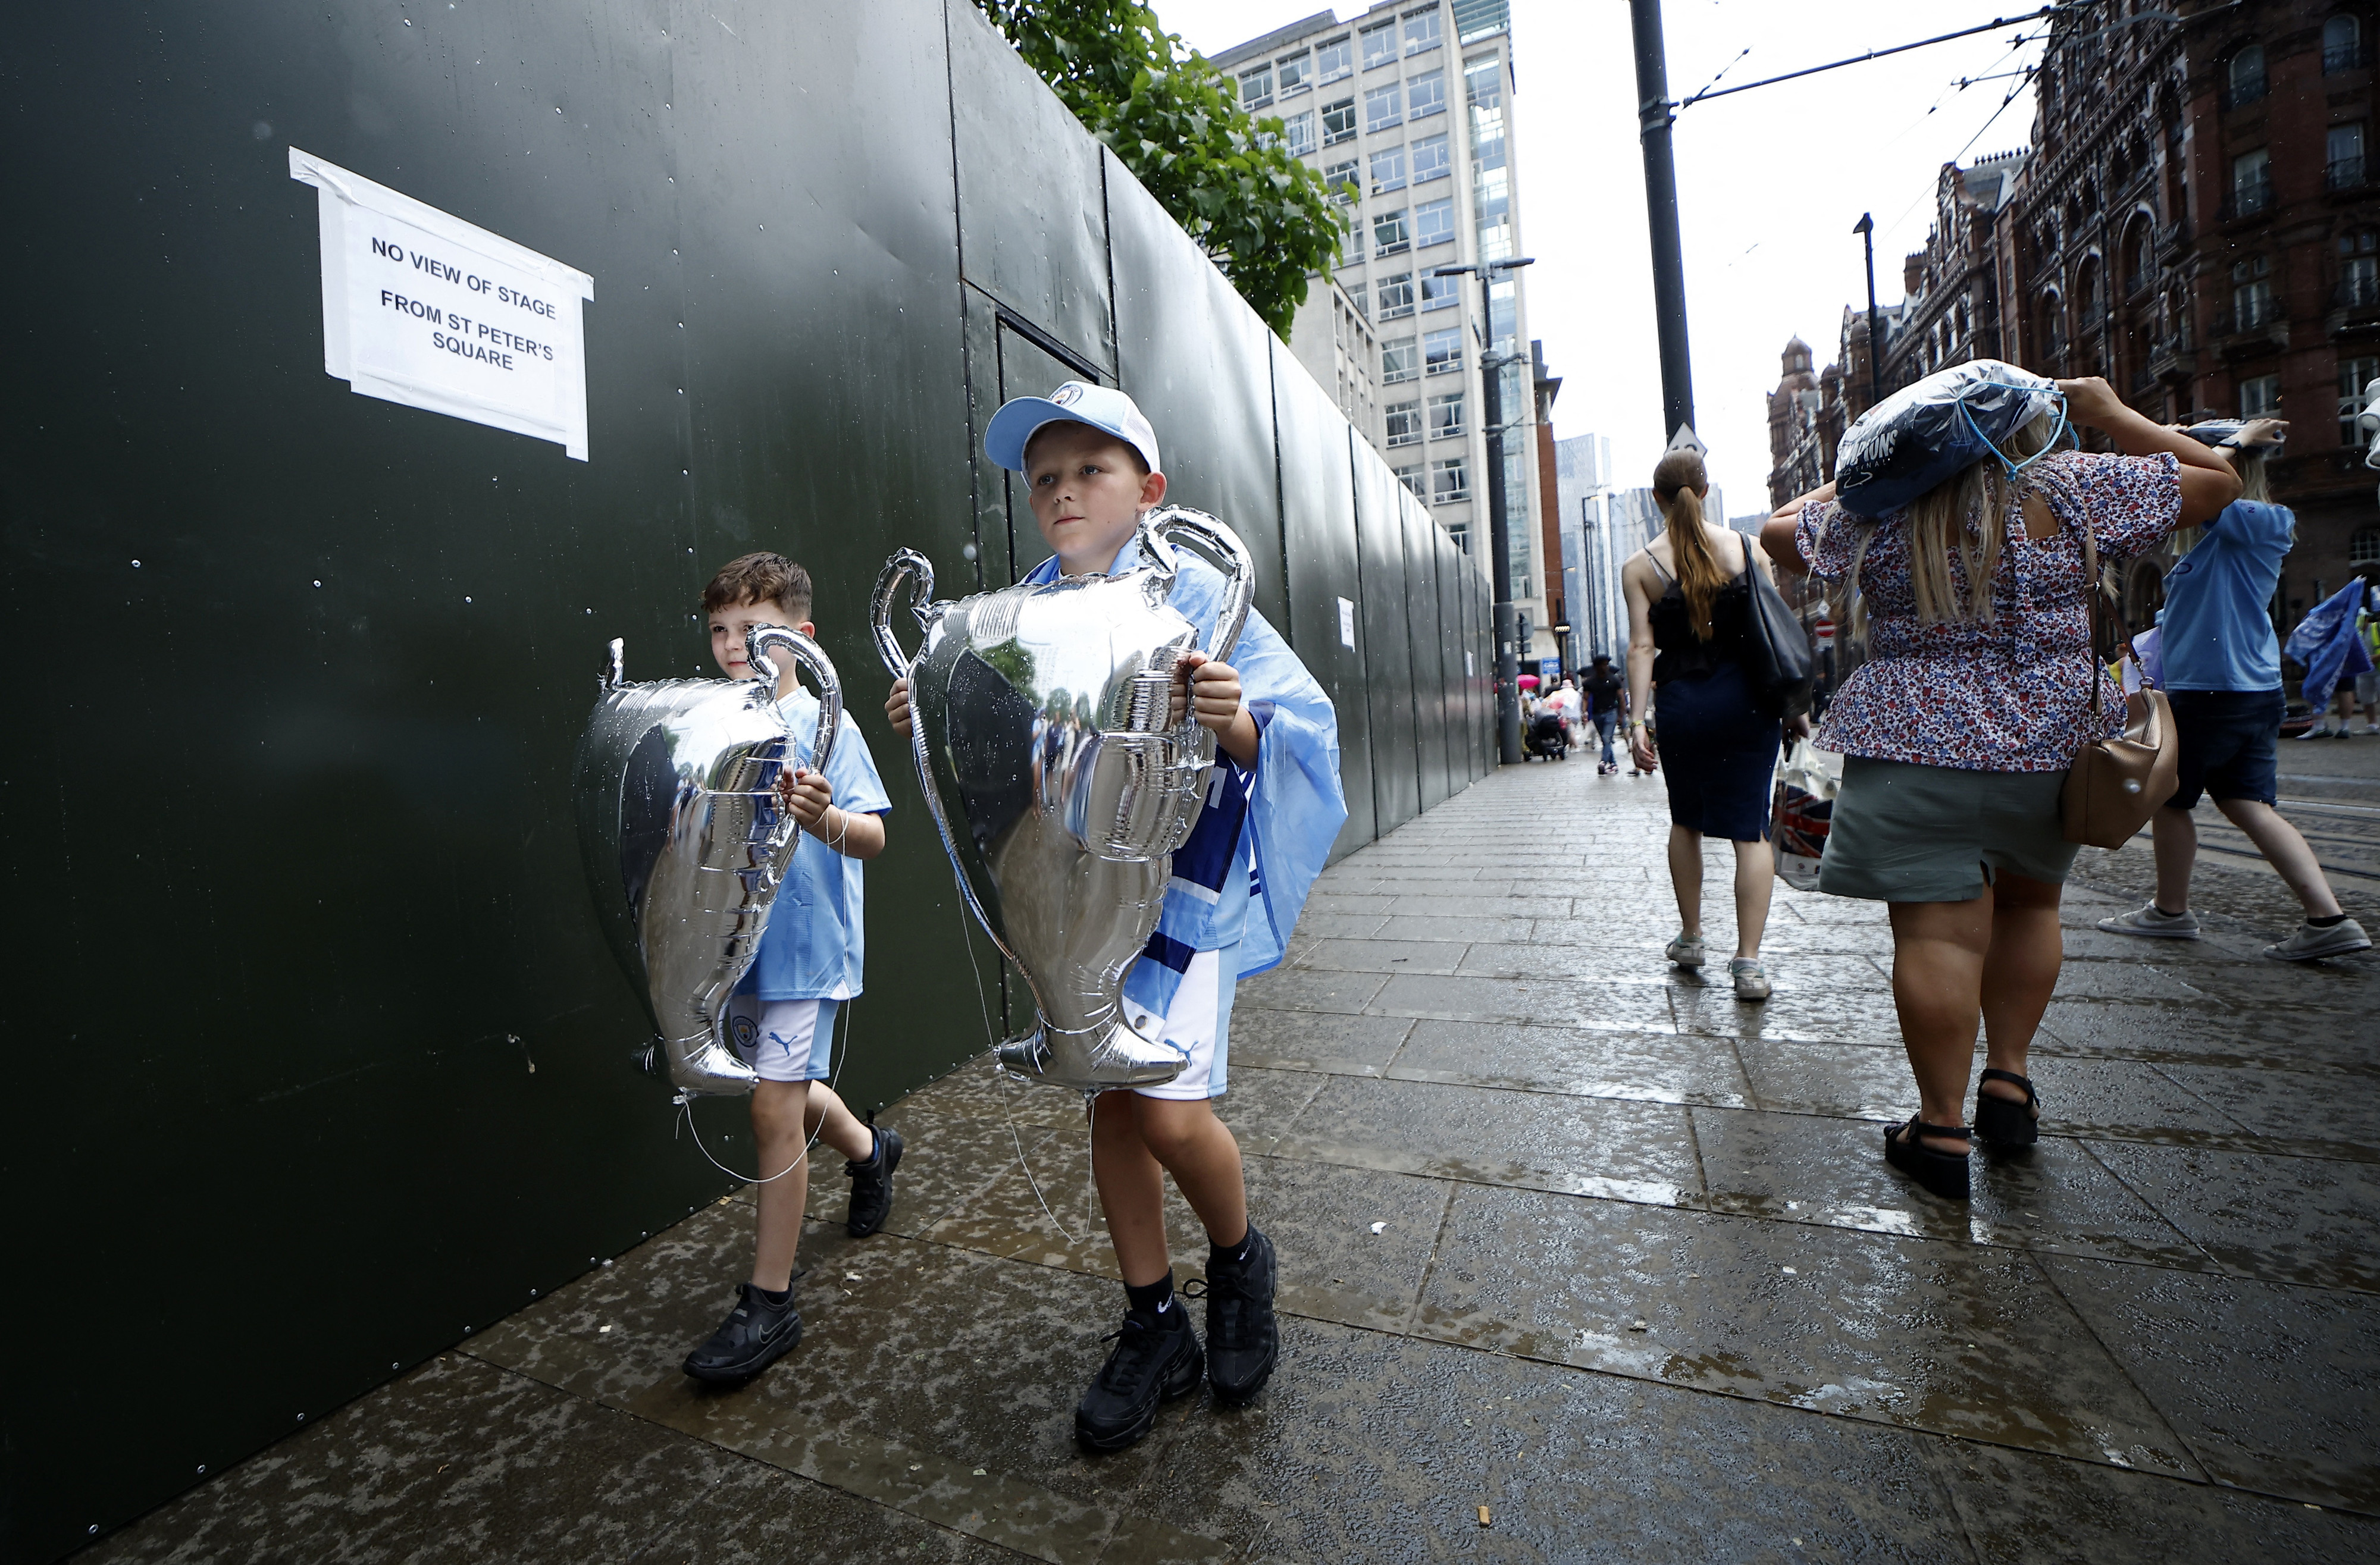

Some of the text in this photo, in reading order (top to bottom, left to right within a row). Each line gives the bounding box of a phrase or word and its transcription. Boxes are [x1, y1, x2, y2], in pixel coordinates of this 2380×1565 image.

[372, 237, 556, 320] NO VIEW OF STAGE
[381, 289, 553, 360] FROM ST PETER'S
[433, 332, 513, 371] SQUARE
